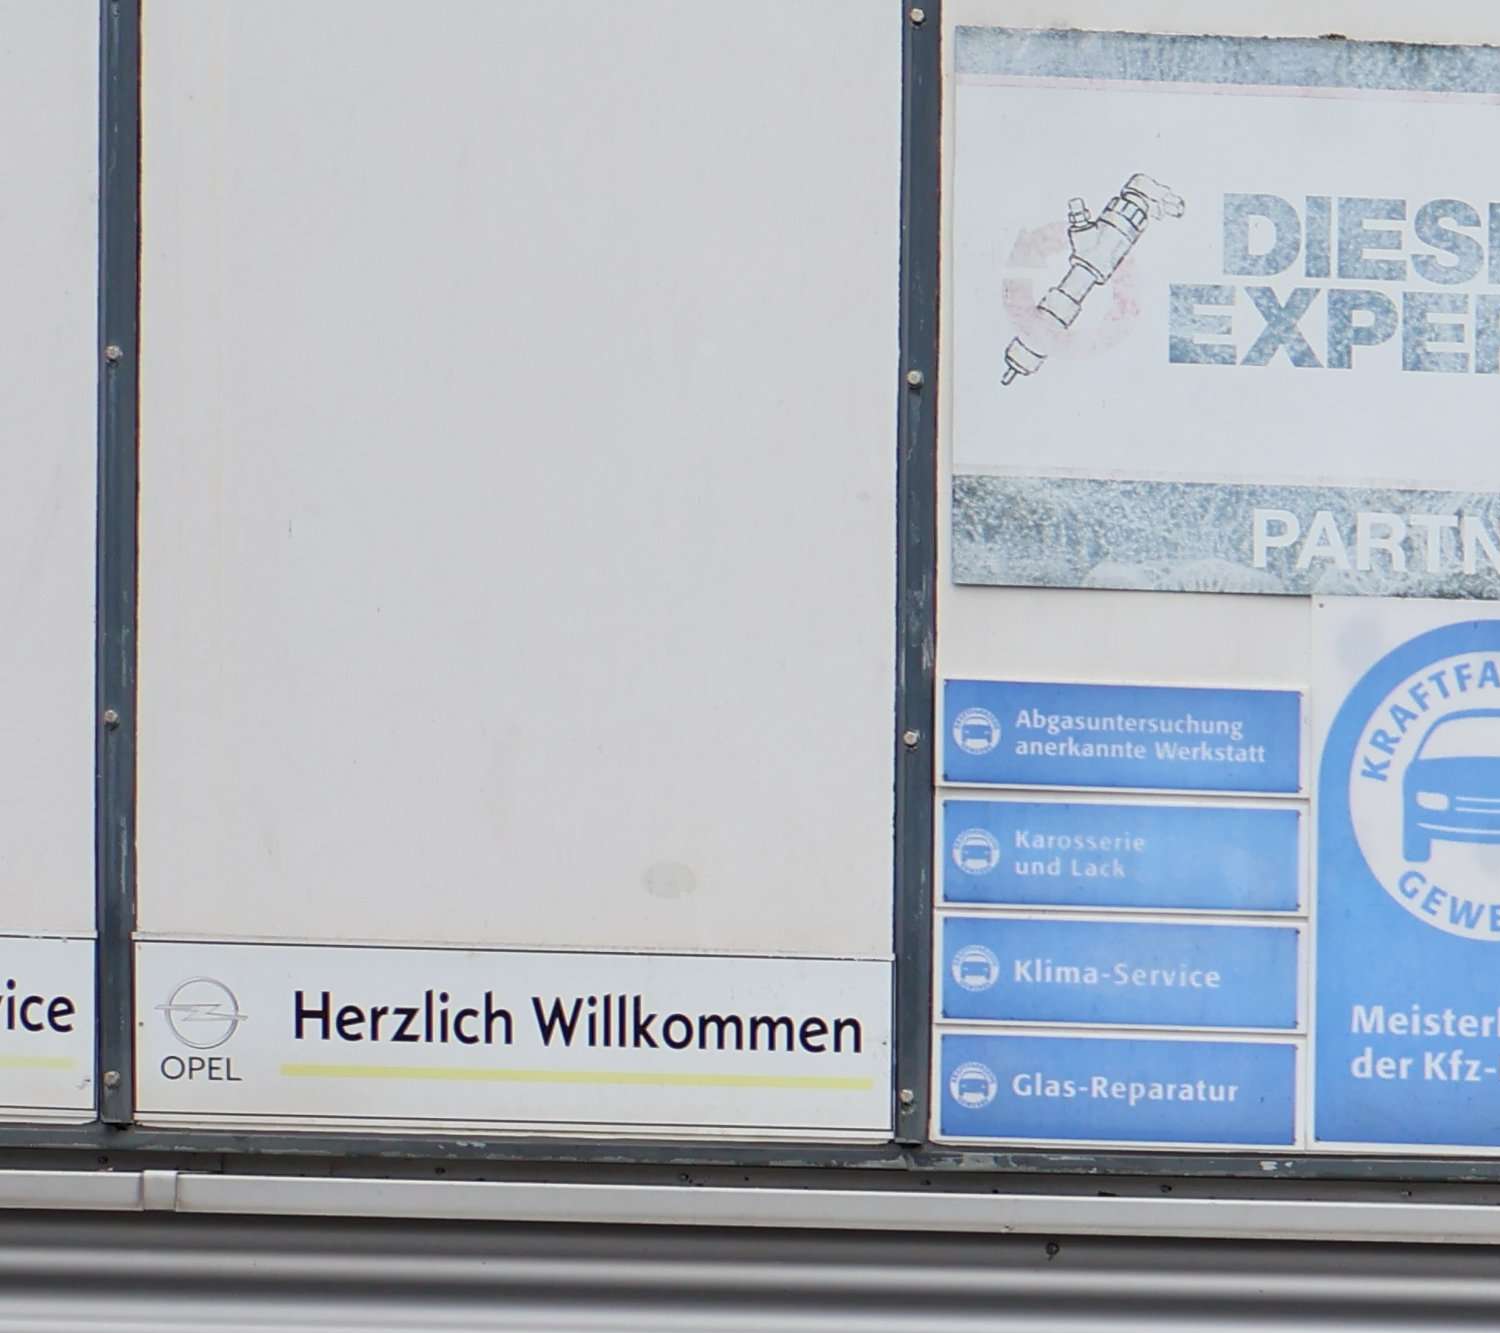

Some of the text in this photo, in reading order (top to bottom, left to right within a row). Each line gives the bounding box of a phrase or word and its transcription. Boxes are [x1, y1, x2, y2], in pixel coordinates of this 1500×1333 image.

[1015, 709, 1244, 742] Abgasuntersuchung
[1015, 737, 1266, 764] anerkannte Werkstatt
[1015, 829, 1146, 854] Karosserie
[1015, 856, 1126, 880] und Lack
[1014, 960, 1221, 989] Klima-Service
[0, 978, 76, 1033] ice
[294, 989, 864, 1055] Herzlich Willkommen
[161, 1056, 242, 1082] OPEL
[1351, 1049, 1412, 1082] der
[1012, 1074, 1240, 1107] Glas-Reparatur
